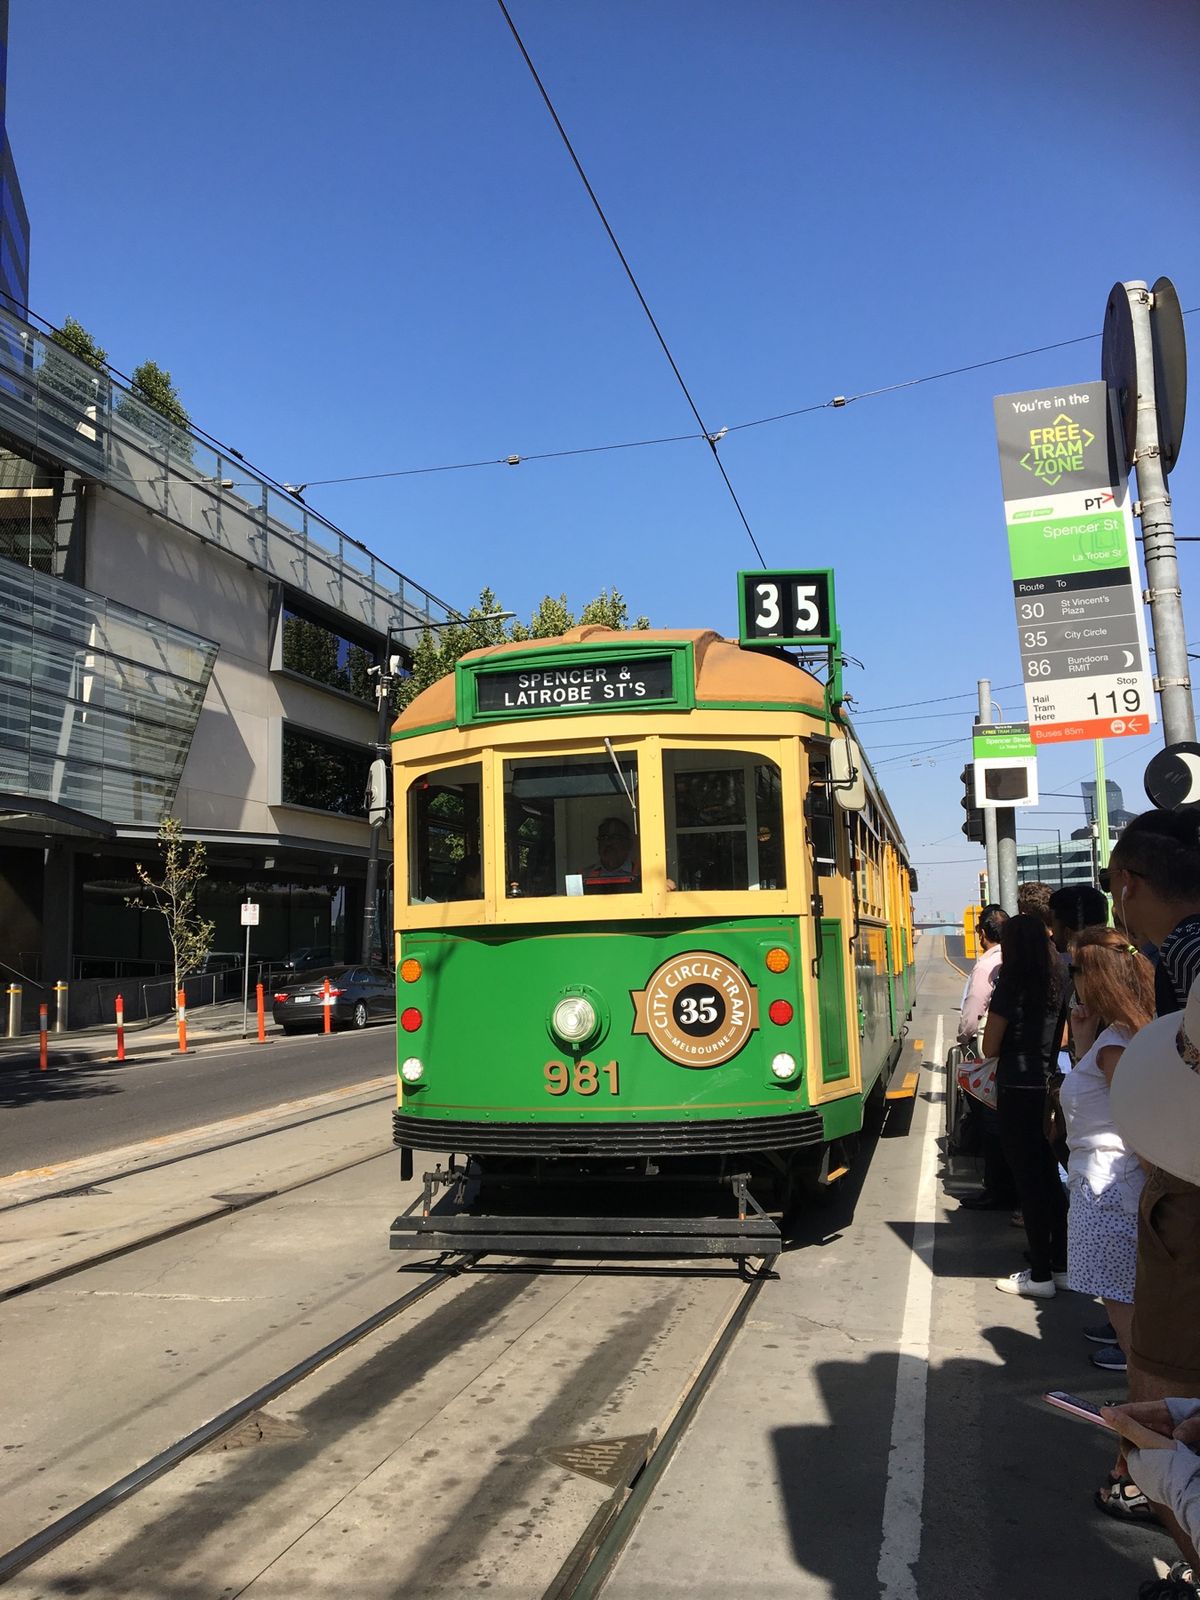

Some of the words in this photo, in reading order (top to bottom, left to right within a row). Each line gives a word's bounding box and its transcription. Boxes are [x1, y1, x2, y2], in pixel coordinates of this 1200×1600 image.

[1012, 398, 1052, 414] You're
[1054, 396, 1066, 408] in
[1068, 394, 1090, 405] the
[1030, 424, 1080, 445] FREE
[1030, 440, 1083, 460] TRAM
[1033, 455, 1085, 476] ZONE
[1043, 522, 1100, 539] Spencer
[1104, 519, 1118, 530] St
[1086, 551, 1110, 560] Trobe
[1112, 549, 1121, 558] St
[1019, 582, 1044, 592] Route
[1056, 580, 1066, 588] To
[1060, 599, 1070, 608] St
[1072, 596, 1110, 606] Vincent's
[1021, 602, 1044, 620] 30
[1062, 606, 1084, 616] Plaza
[1024, 631, 1048, 648] 35
[1064, 630, 1082, 640] City
[1083, 628, 1108, 638] Circle
[1028, 660, 1051, 676] 86
[1068, 654, 1108, 665] Bundoora
[518, 668, 607, 688] SPENCER
[619, 666, 631, 680] &
[1068, 664, 1090, 673] RMIT
[1116, 677, 1138, 686] Stop
[504, 686, 592, 707] LATROBE
[603, 682, 646, 699] ST'S
[1032, 695, 1050, 704] Hail
[1086, 688, 1141, 716] 119
[1034, 704, 1056, 712] Tram
[1034, 712, 1056, 722] Here
[1036, 728, 1062, 738] Buses
[1064, 726, 1084, 736] 85m
[654, 988, 668, 1028] CITY
[666, 963, 722, 988] CIRCLE
[722, 976, 744, 1026] TRAM
[680, 996, 718, 1024] 35
[672, 1036, 730, 1054] MELBOURNE
[543, 1060, 619, 1095] 981
